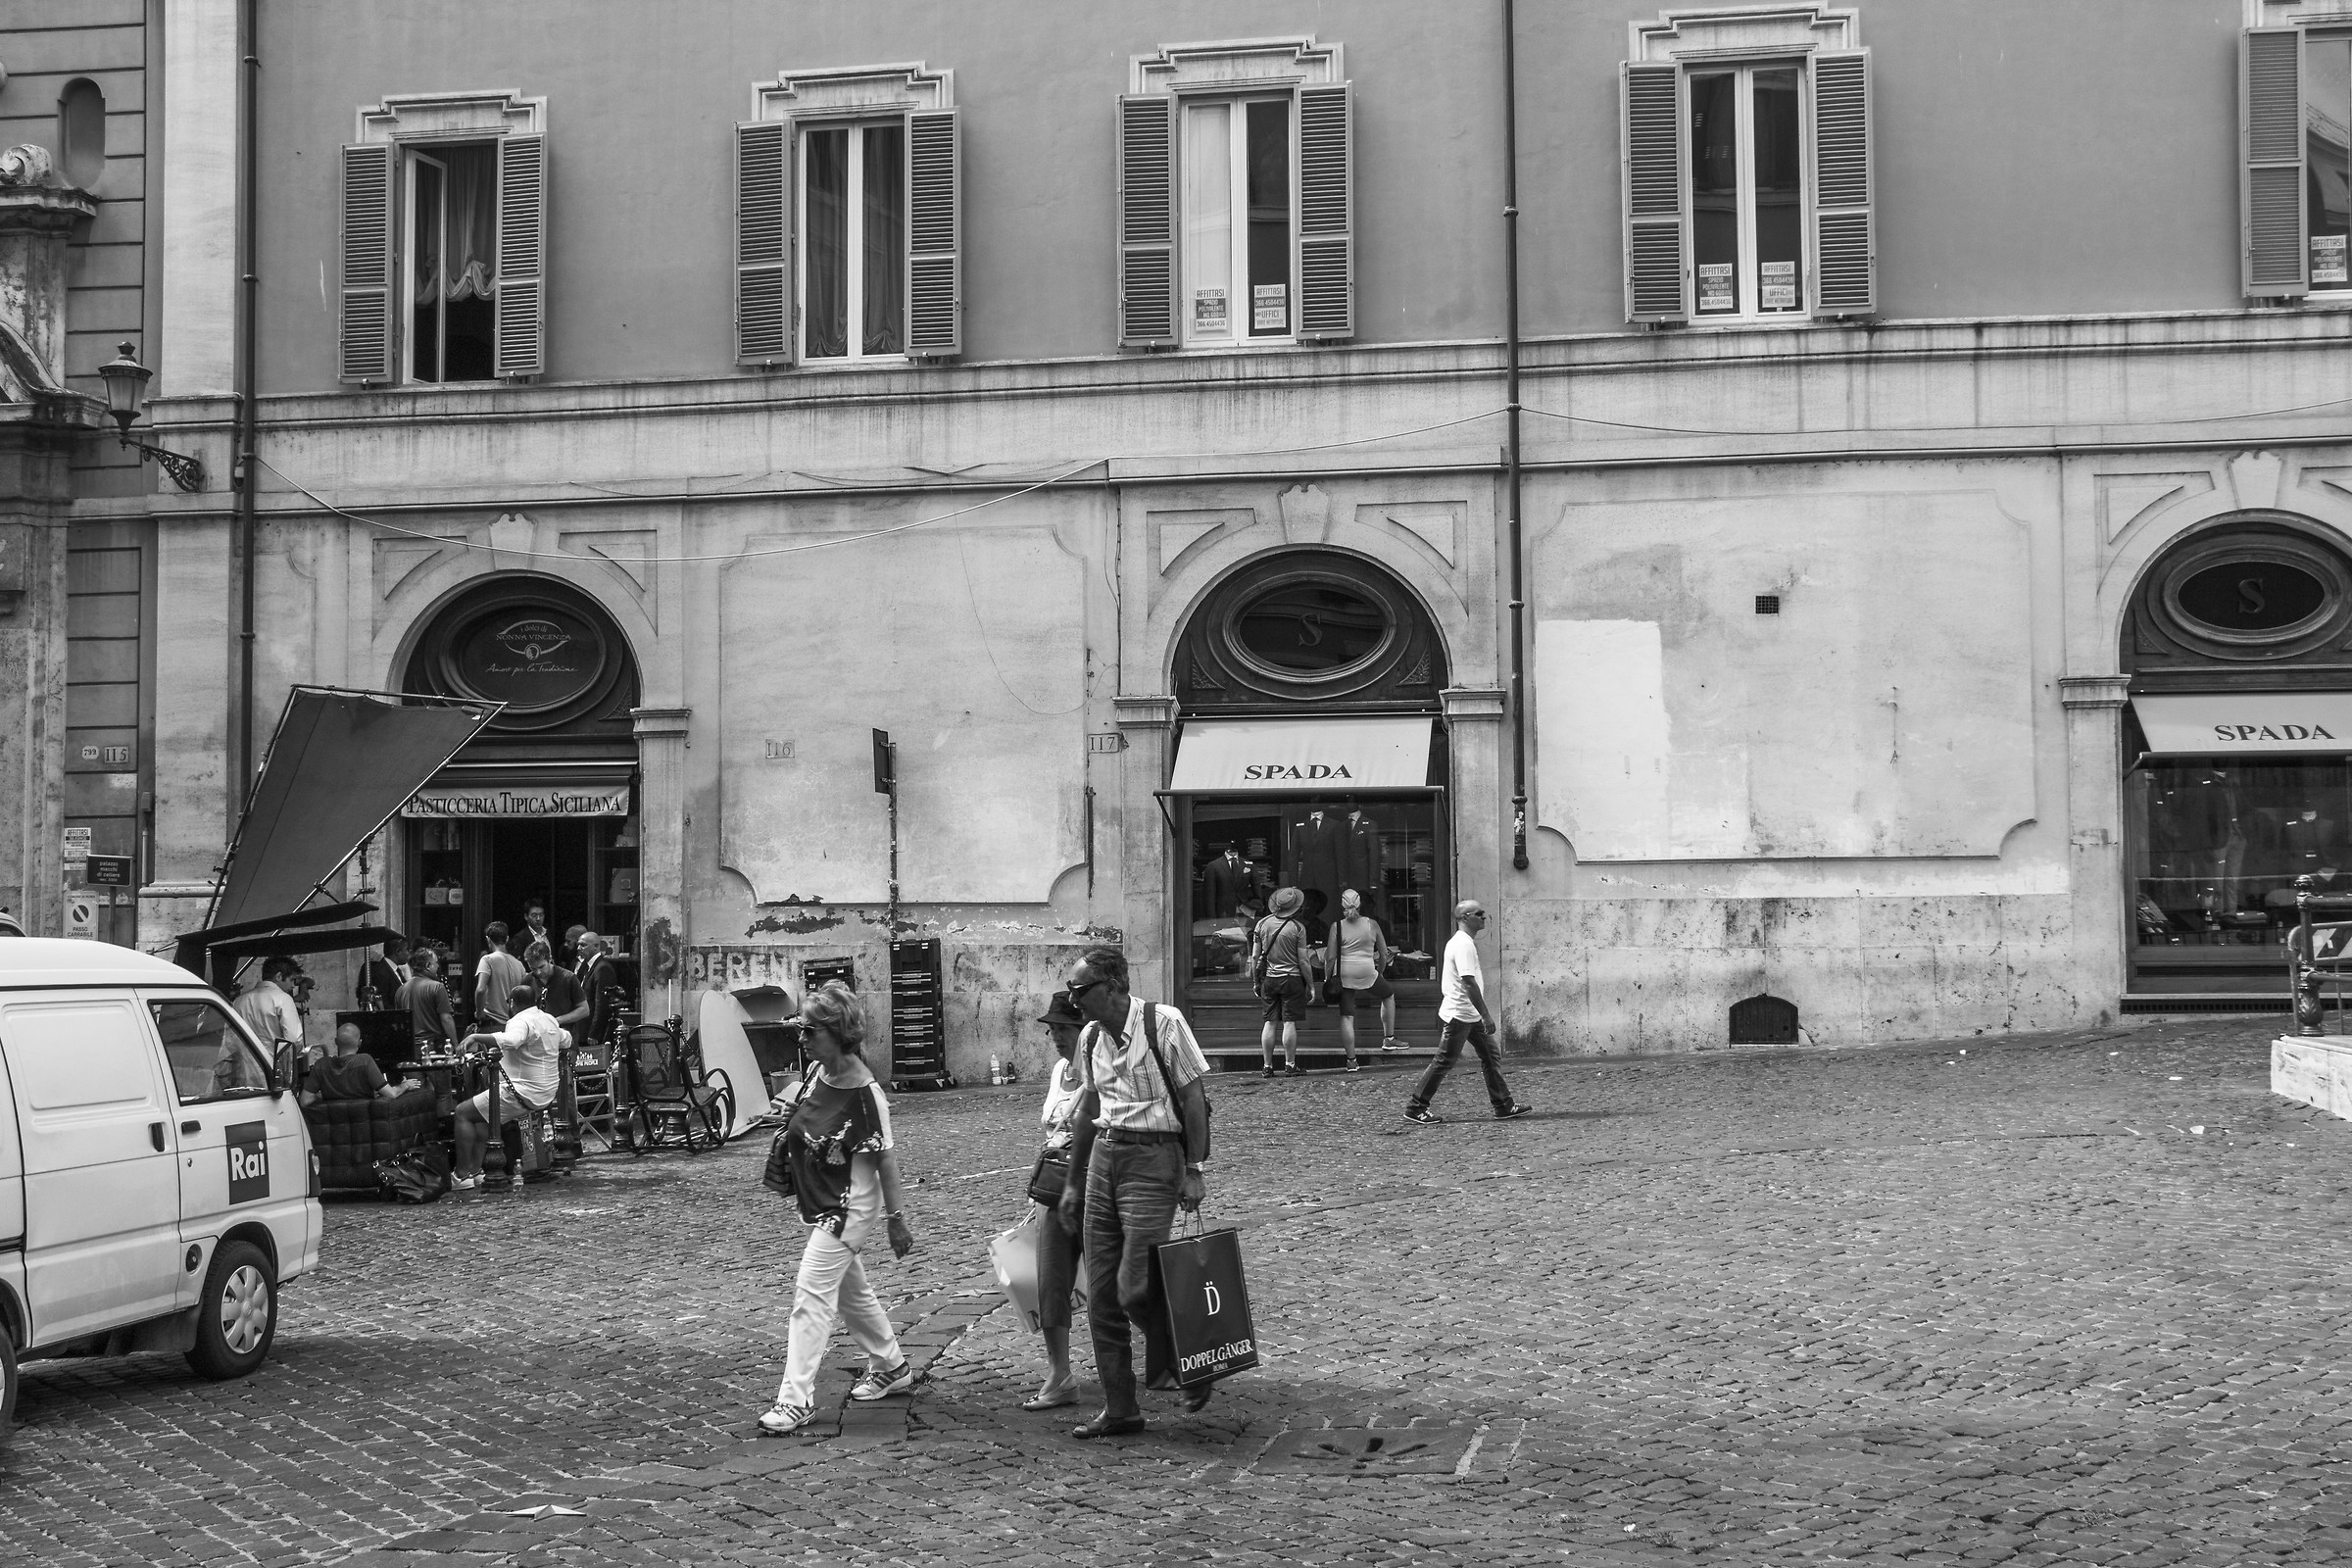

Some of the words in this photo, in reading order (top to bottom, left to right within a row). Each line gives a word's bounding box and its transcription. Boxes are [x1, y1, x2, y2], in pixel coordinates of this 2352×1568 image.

[2313, 239, 2344, 248] AFFITTASI
[1700, 266, 1731, 275] AFFITTASI
[1764, 264, 1791, 272] AFFITTASI
[1197, 289, 1225, 298] AFFITTASI
[1255, 287, 1282, 296] AFFITTASI
[1261, 310, 1280, 318] UFFICI
[2238, 578, 2265, 613] S
[1298, 612, 1323, 647] S
[2214, 724, 2336, 741] SPADA
[767, 742, 793, 757] 116
[1091, 736, 1115, 751] 117
[106, 748, 127, 761] 115
[1244, 764, 1353, 780] SPADA
[408, 793, 498, 814] PASTICCERIA
[500, 792, 547, 813] TIPICA
[550, 792, 622, 813] SICILIANA
[230, 1141, 266, 1182] Rai
[1212, 1362, 1229, 1372] ROMA
